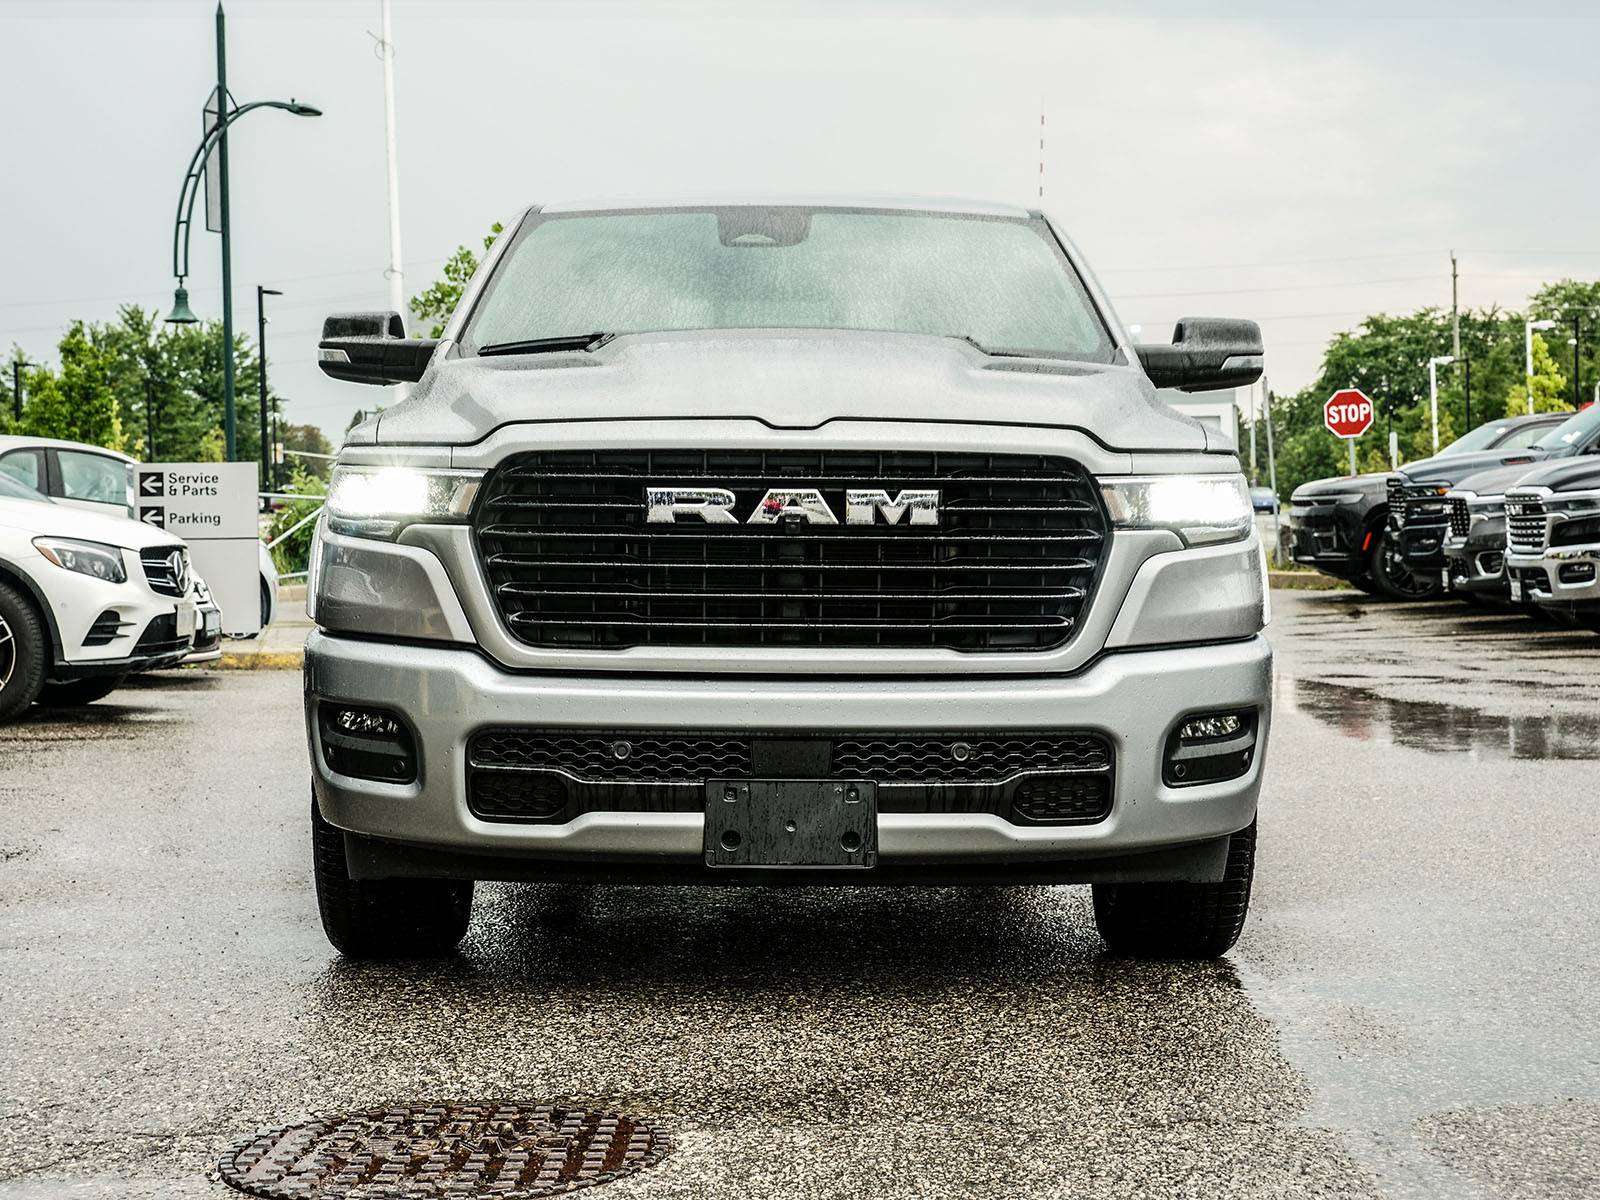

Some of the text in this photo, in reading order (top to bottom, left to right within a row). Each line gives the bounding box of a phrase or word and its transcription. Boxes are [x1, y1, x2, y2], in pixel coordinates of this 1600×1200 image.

[1328, 403, 1370, 424] STOP
[168, 472, 219, 484] Service
[168, 484, 218, 496] & Parts
[646, 487, 939, 525] RAM
[169, 512, 221, 526] Parking
